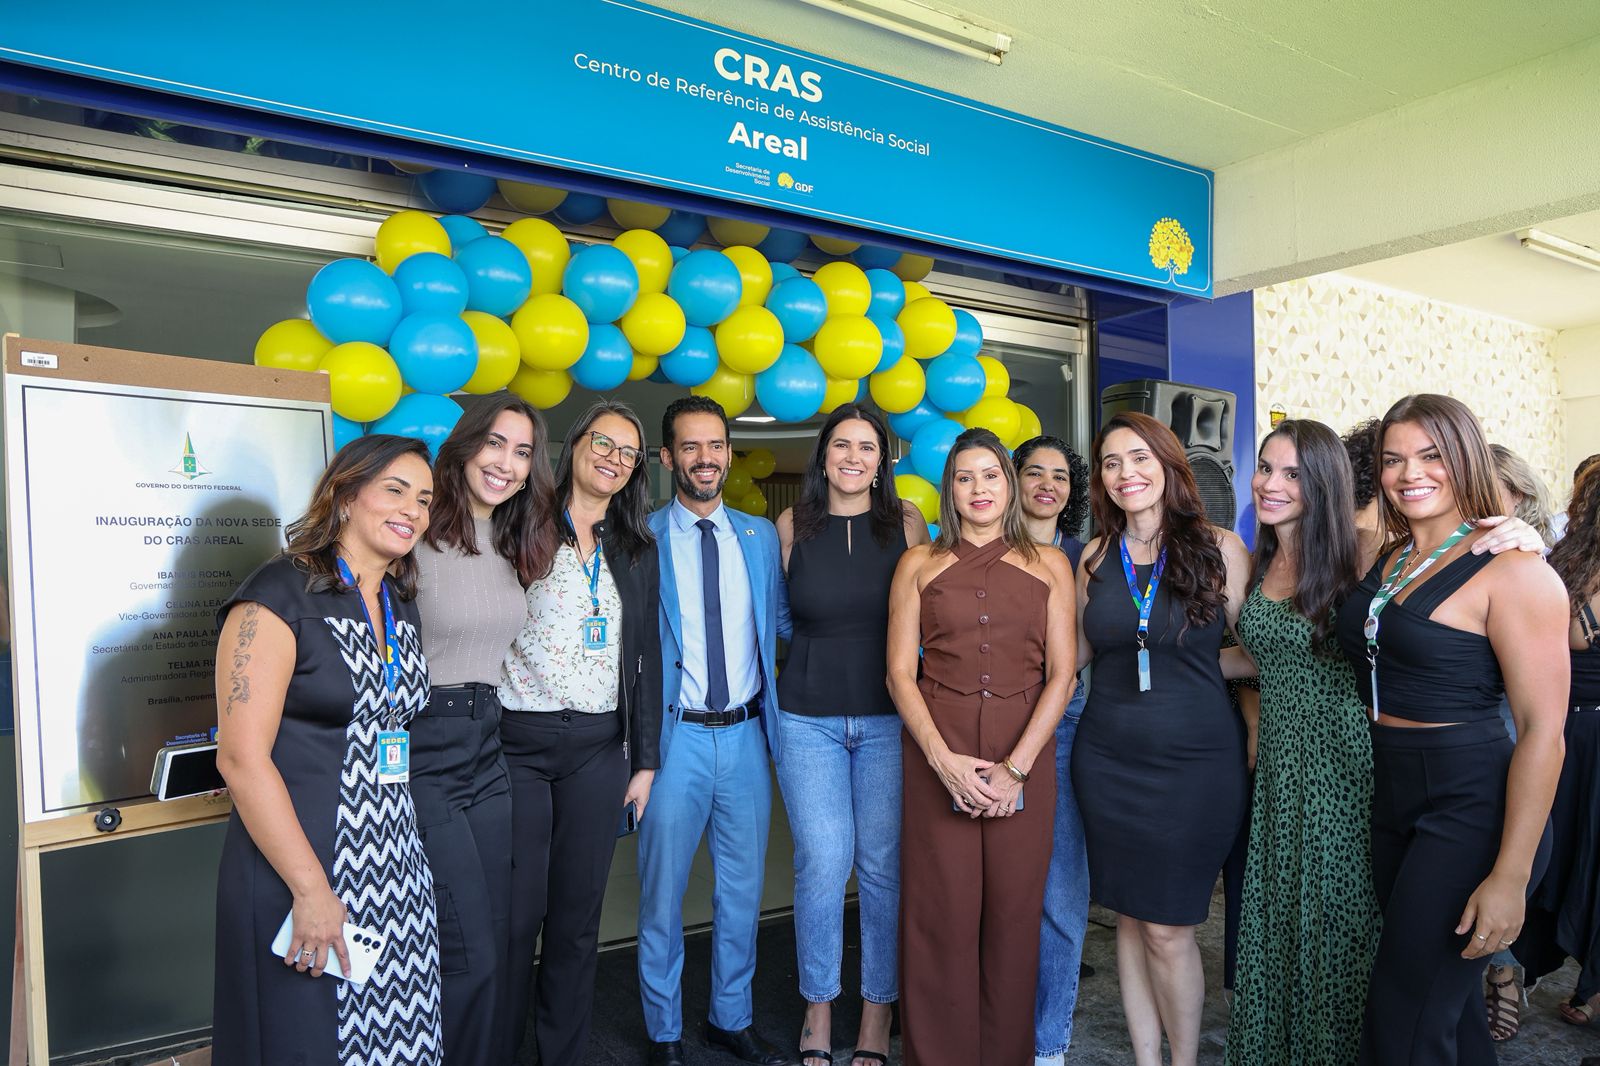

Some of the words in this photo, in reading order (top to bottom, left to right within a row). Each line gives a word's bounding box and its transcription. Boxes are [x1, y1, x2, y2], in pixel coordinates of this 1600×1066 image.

[713, 48, 823, 103] CRAS
[573, 53, 642, 82] Centro
[646, 72, 670, 89] de
[676, 78, 769, 115] Referência
[774, 104, 795, 121] de
[799, 110, 884, 145] Assistência
[888, 134, 930, 157] Social
[728, 121, 807, 161] Areal
[735, 162, 762, 173] Secretaria
[725, 166, 770, 181] Desenvolvimento
[754, 178, 770, 187] Social
[794, 182, 814, 193] GDF
[96, 515, 192, 529] INAUGURAÇÃO
[195, 518, 213, 527] DA
[216, 518, 249, 527] NOVA
[252, 518, 282, 527] SEDE
[144, 536, 162, 545] DO
[166, 536, 200, 545] CRAS
[204, 536, 243, 545] AREAL
[199, 570, 232, 578] ROCHA
[129, 581, 185, 590] Governad
[198, 580, 227, 589] Distrito
[166, 601, 200, 609] CELINA
[118, 610, 197, 620] Vice-Governadora
[200, 609, 211, 617] do
[153, 631, 173, 640] ANA
[176, 630, 208, 639] PAULA
[92, 643, 139, 654] Secretária
[142, 643, 153, 651] de
[156, 641, 186, 650] Estado
[188, 640, 199, 648] de
[168, 660, 200, 670] TELMA
[121, 671, 187, 684] Administradora
[148, 695, 183, 706] Brasília,
